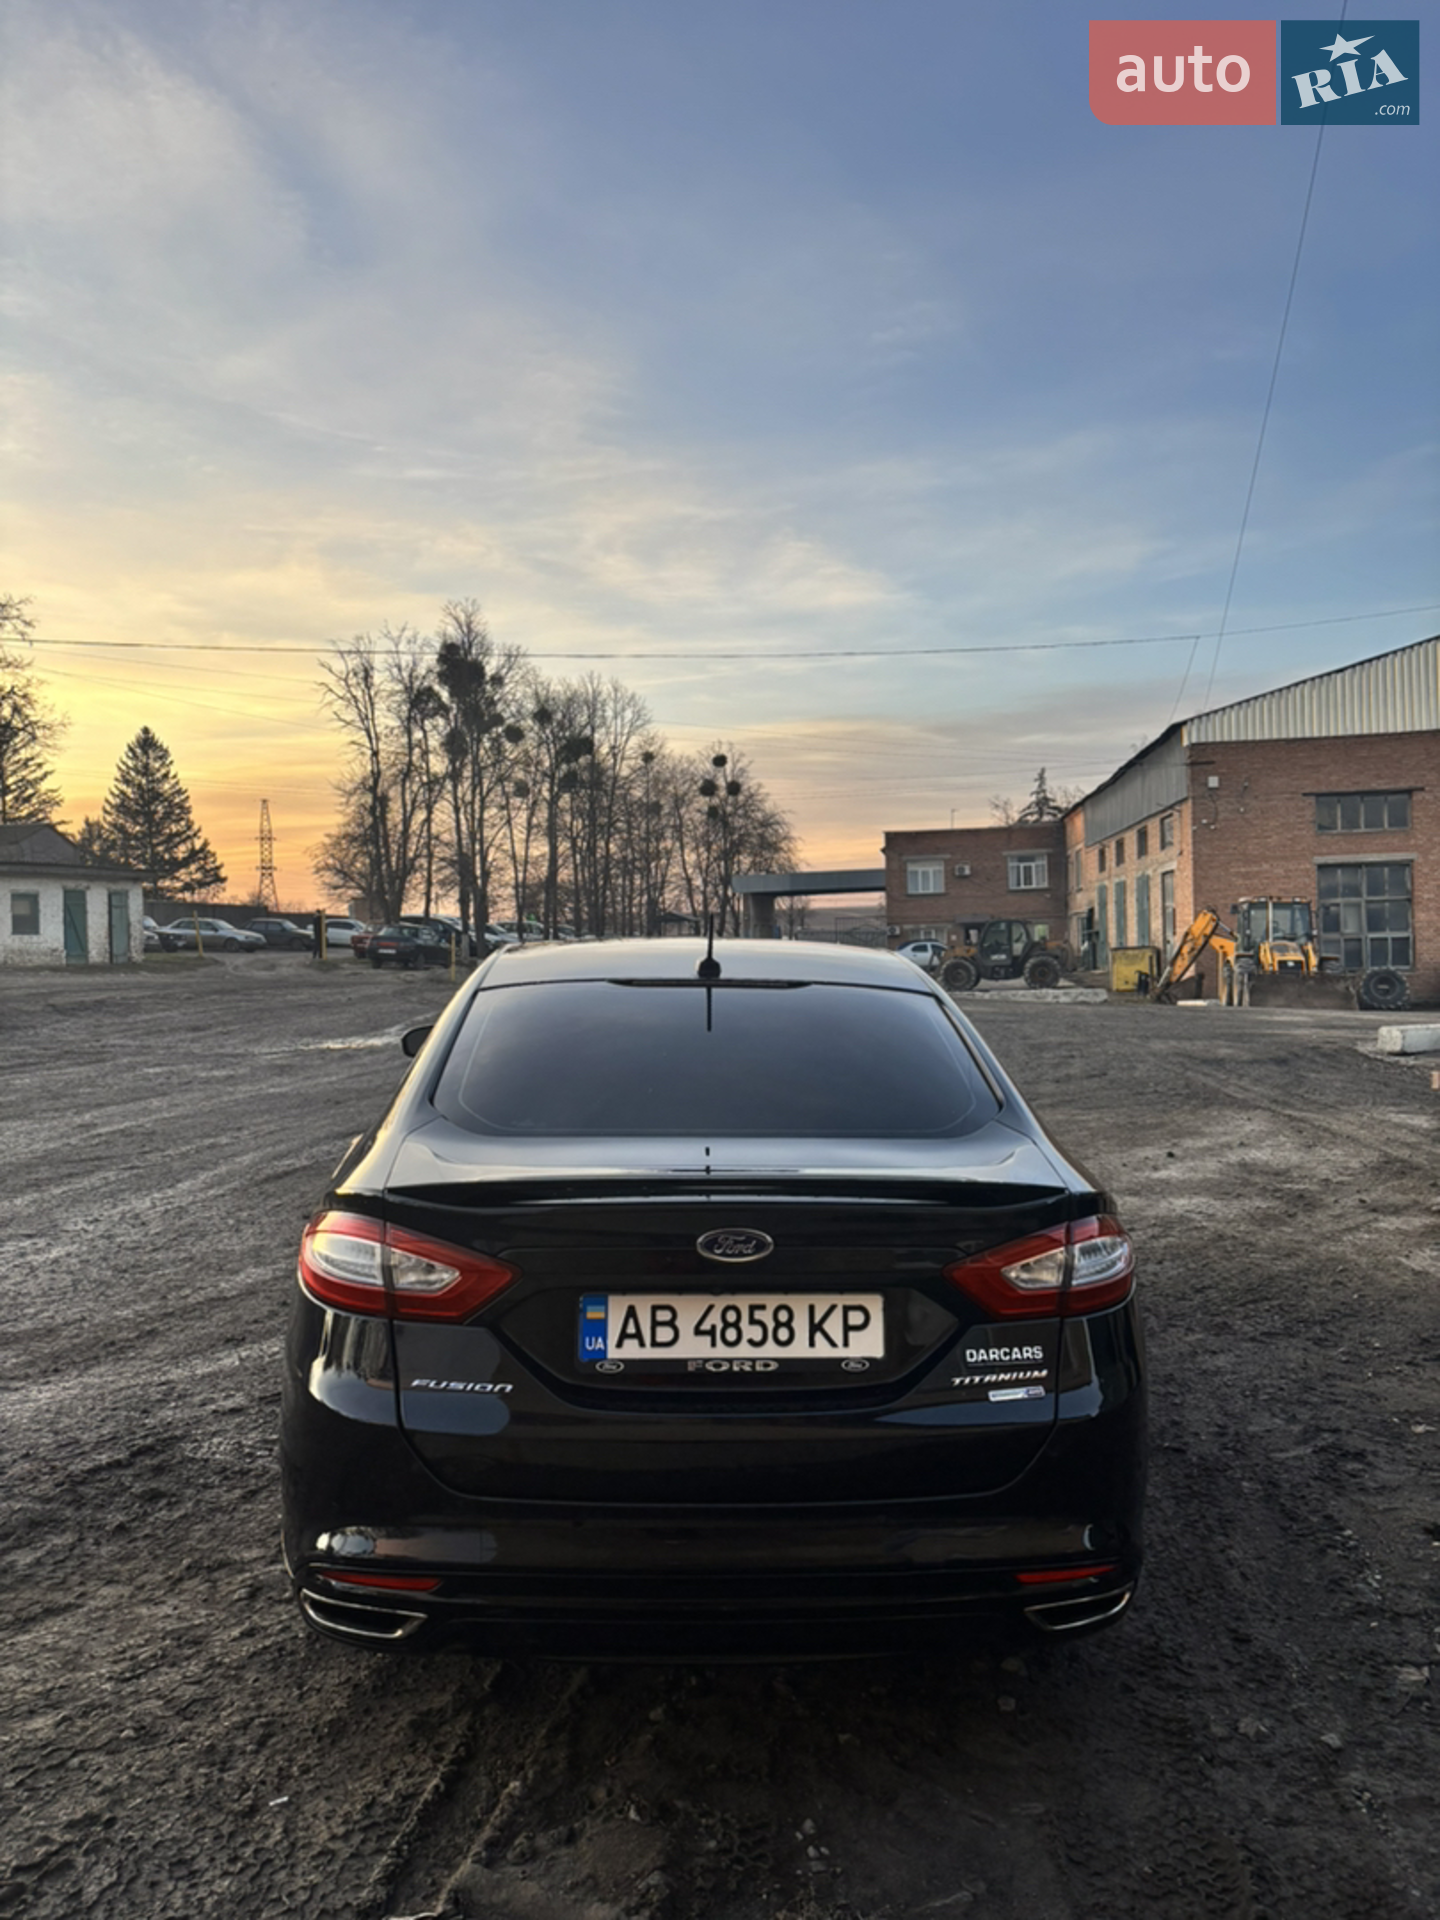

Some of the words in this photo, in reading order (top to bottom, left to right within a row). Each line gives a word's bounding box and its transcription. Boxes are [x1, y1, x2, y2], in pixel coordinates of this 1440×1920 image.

[713, 1234, 757, 1255] Ford
[615, 1304, 679, 1349] AB
[693, 1304, 796, 1349] 4858
[808, 1304, 871, 1348] KP
[585, 1336, 605, 1351] UA
[965, 1345, 1044, 1363] DARCARS
[687, 1359, 779, 1372] FORD
[411, 1378, 514, 1393] FUSION
[951, 1368, 1048, 1387] TITANIUM
